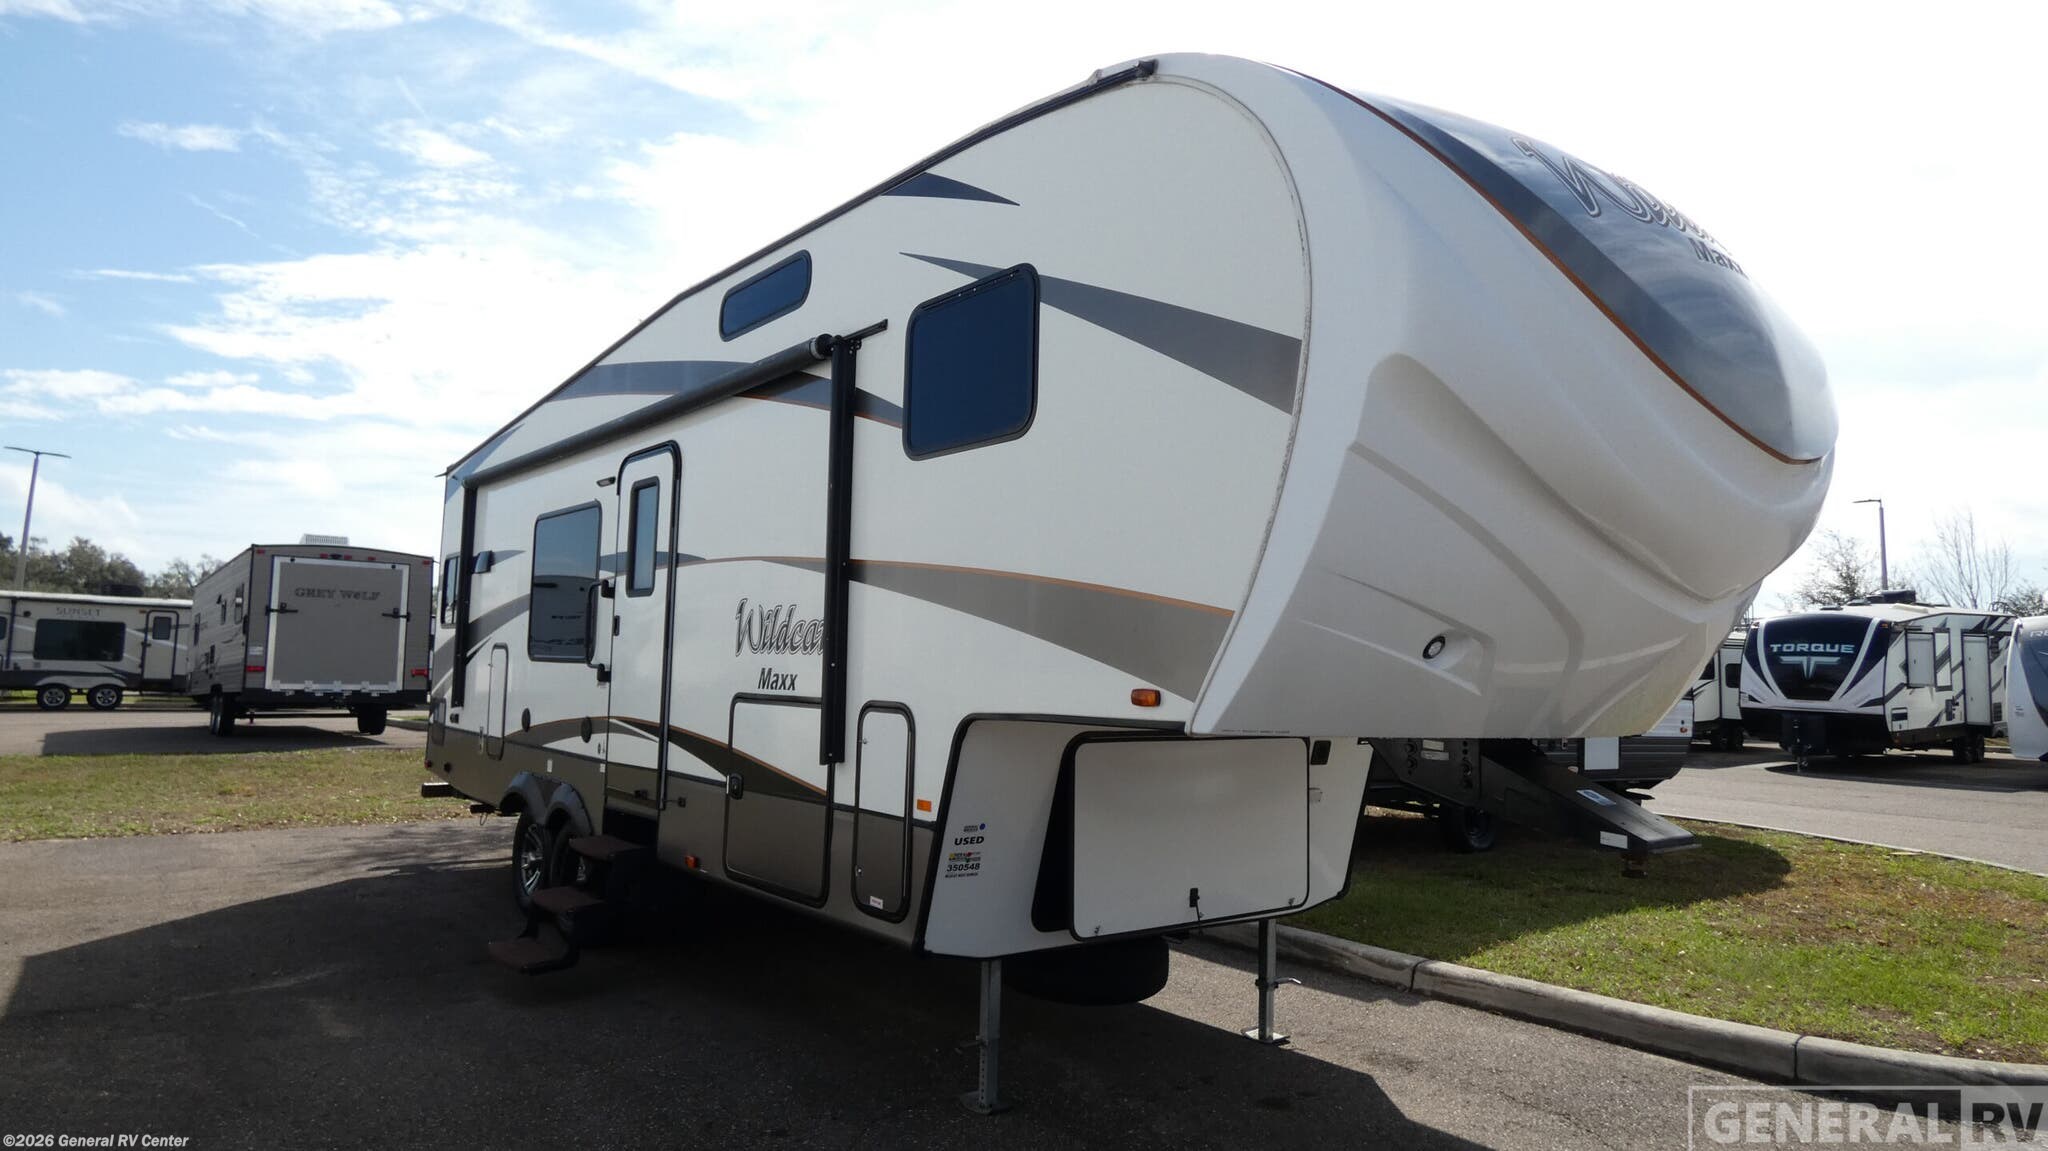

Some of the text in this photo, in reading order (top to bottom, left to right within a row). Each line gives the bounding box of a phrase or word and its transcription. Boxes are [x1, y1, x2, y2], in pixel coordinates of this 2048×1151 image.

[1769, 643, 1855, 654] TORQUE
[757, 667, 798, 691] Maxx
[954, 836, 985, 846] USED
[946, 863, 981, 872] 350548
